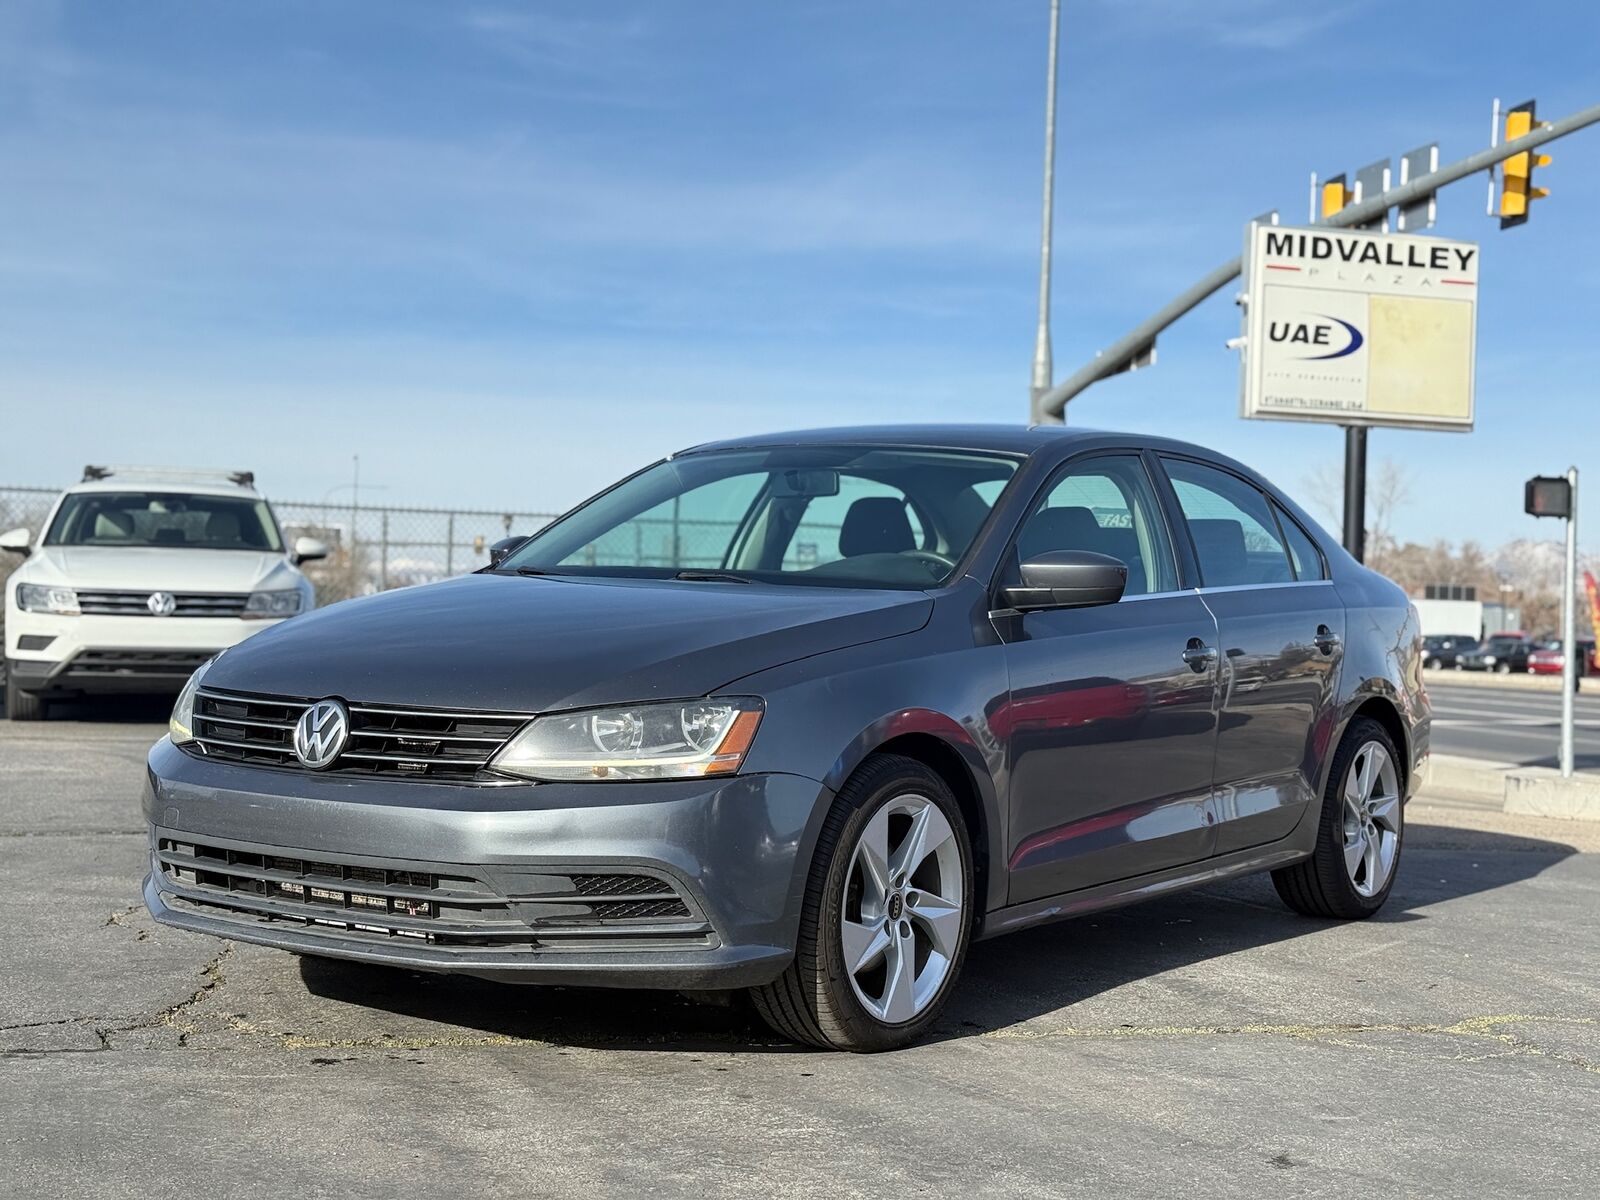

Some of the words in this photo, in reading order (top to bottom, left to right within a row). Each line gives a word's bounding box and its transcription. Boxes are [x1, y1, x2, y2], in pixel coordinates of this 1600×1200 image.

[1266, 232, 1475, 271] MIDVALLEY
[1308, 267, 1433, 287] PLAZA
[1269, 321, 1332, 345] UAE
[1103, 513, 1132, 527] FAS
[294, 700, 347, 769] VW
